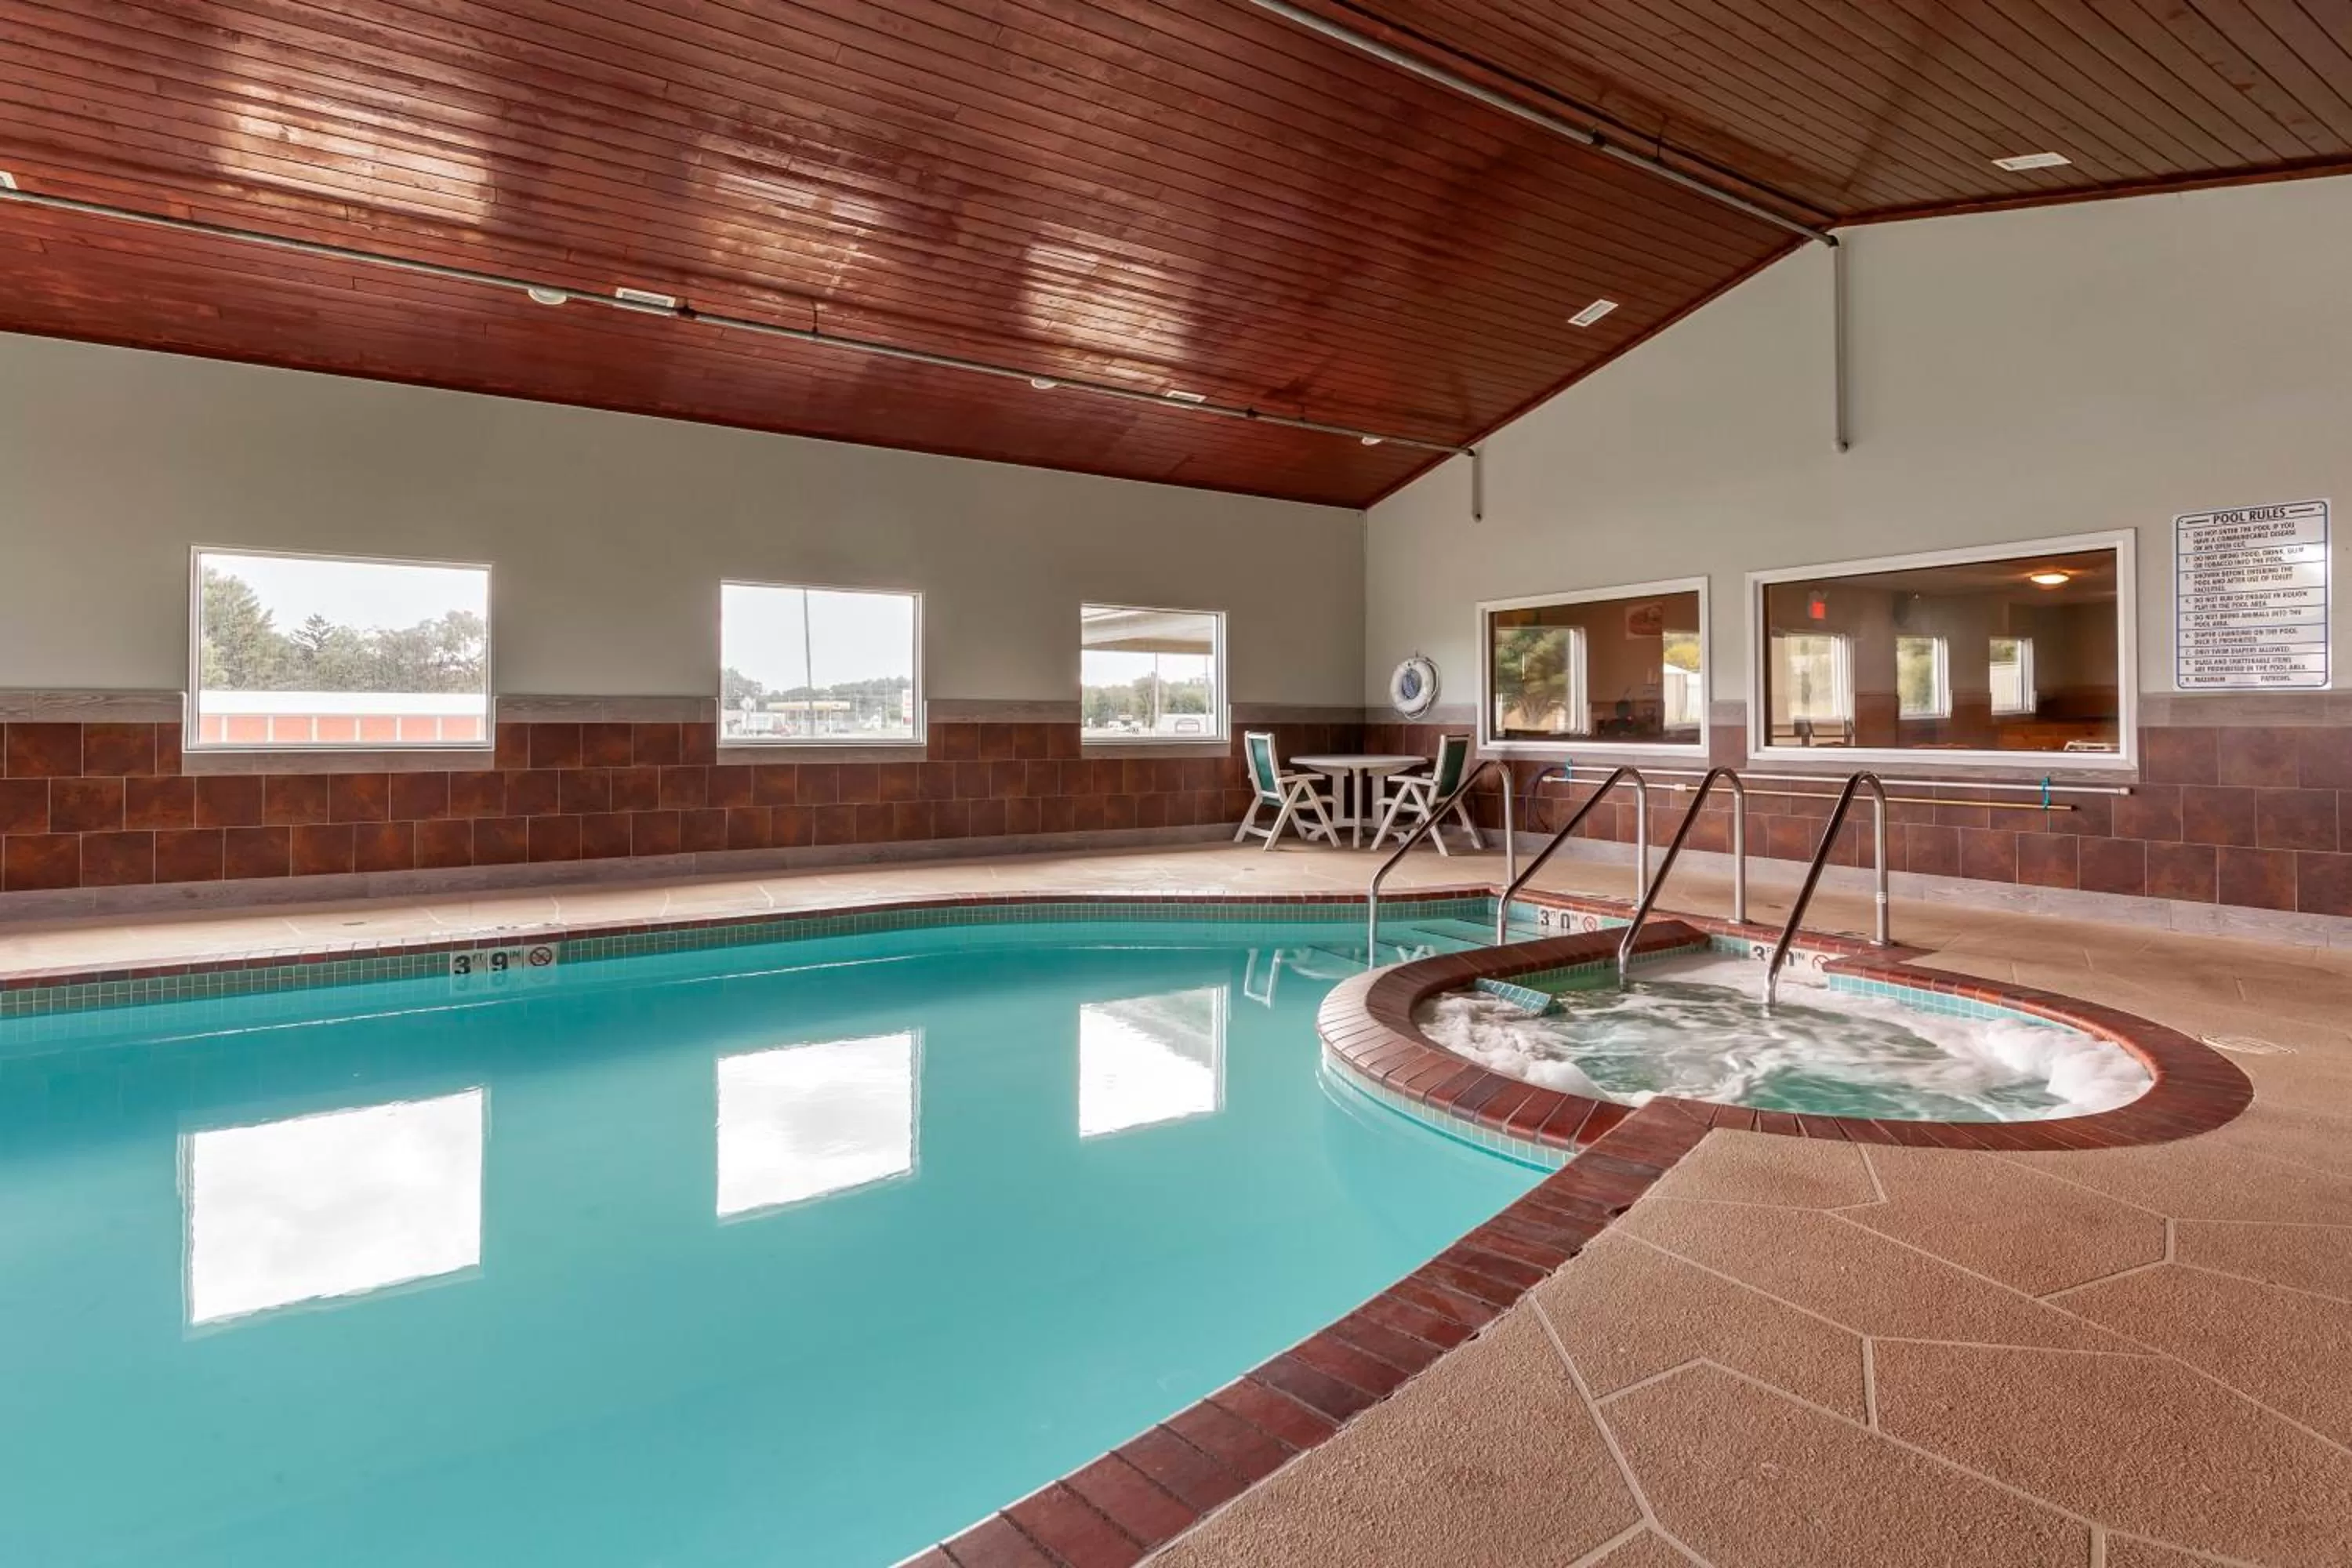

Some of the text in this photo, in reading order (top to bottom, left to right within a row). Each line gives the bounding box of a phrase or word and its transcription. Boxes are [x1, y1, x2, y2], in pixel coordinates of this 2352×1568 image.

[2213, 507, 2285, 524] POOL RULES
[1541, 909, 1549, 925] 3
[455, 955, 470, 975] 3
[473, 953, 484, 963] FT
[492, 951, 508, 971] 9
